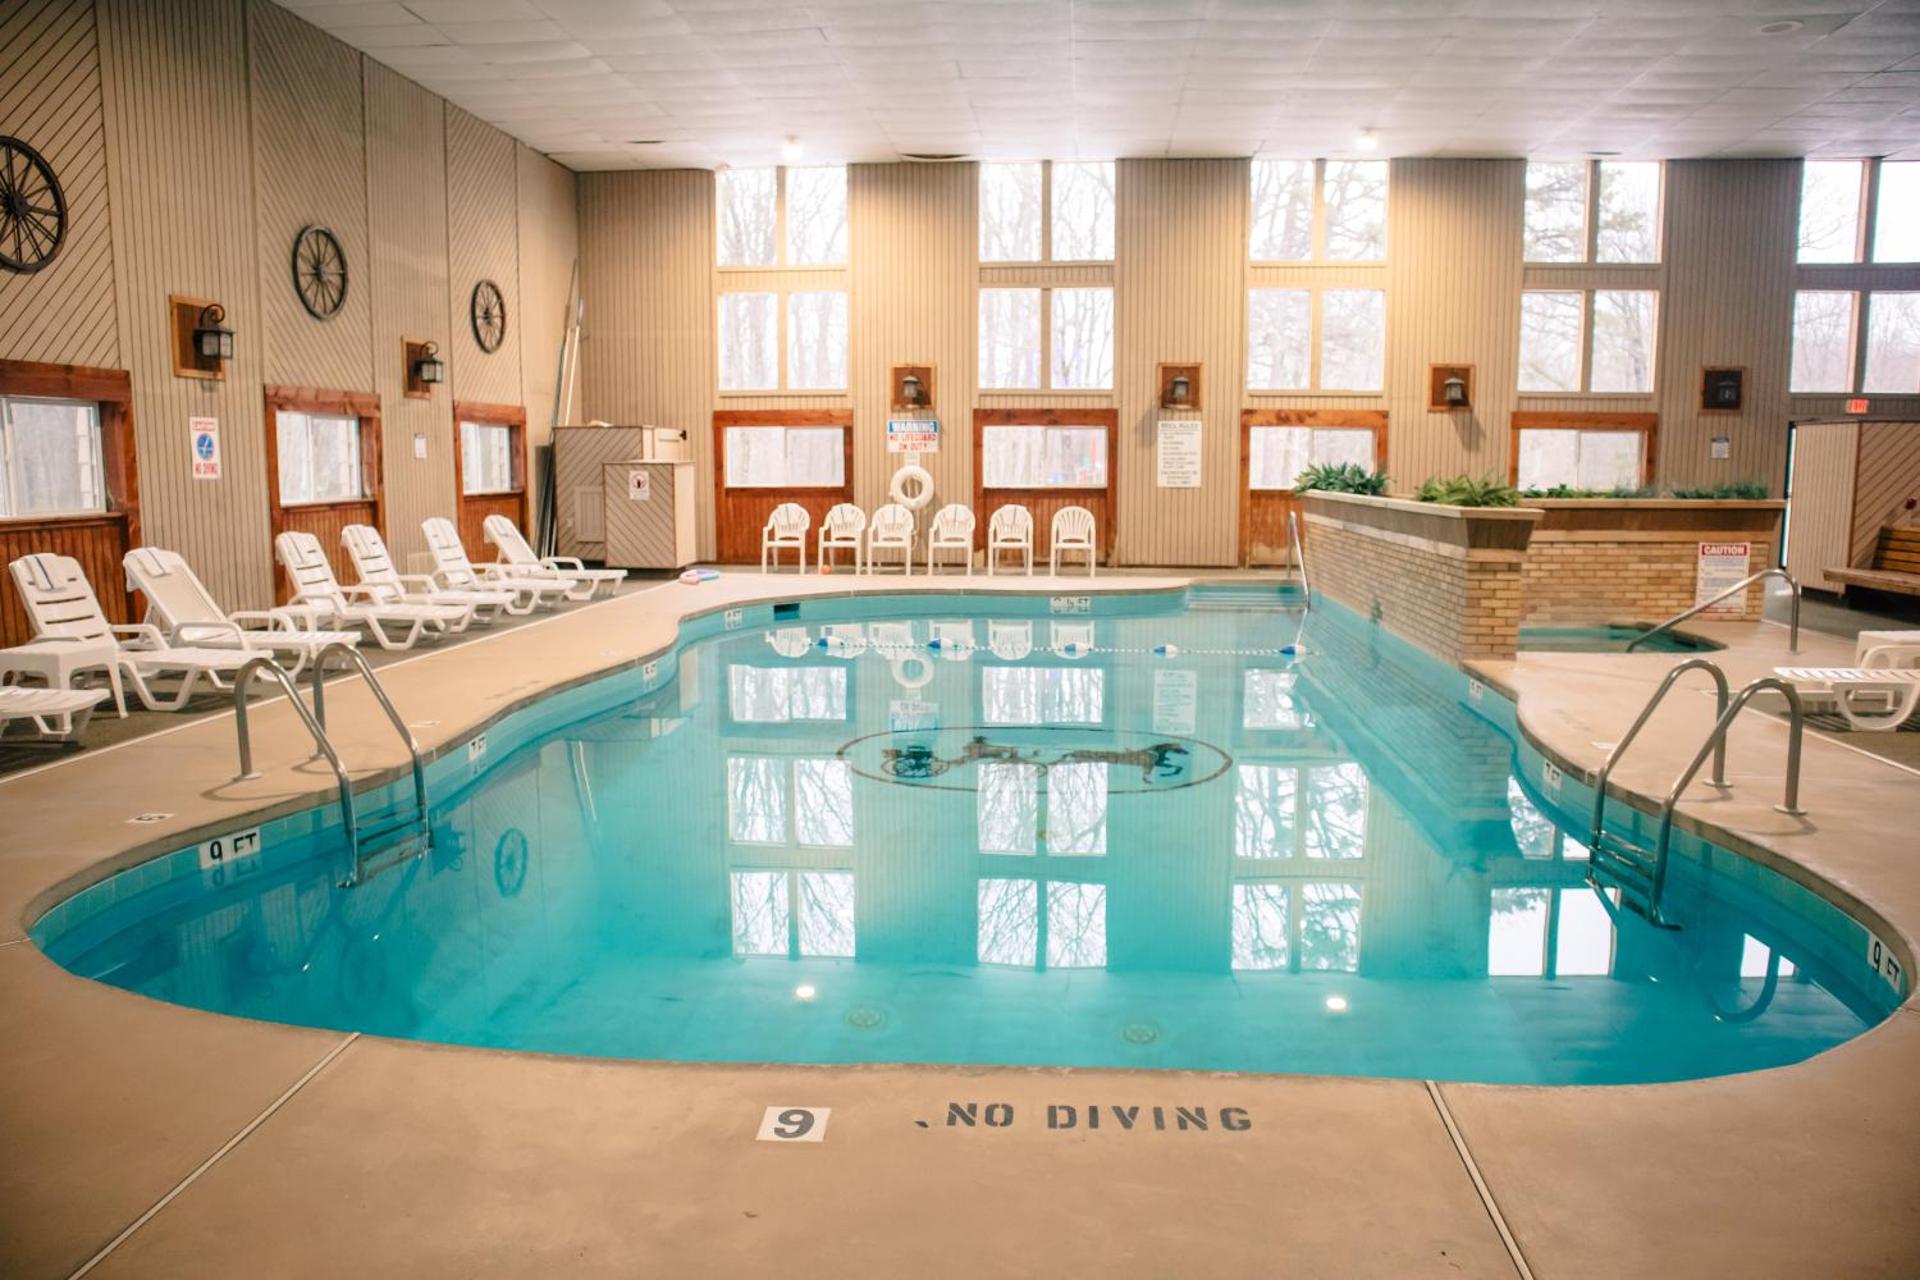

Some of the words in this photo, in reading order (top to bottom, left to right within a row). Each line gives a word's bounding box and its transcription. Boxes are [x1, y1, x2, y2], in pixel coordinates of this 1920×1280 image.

[892, 422, 935, 432] WARNING
[890, 433, 899, 441] NO
[901, 433, 937, 441] LIFEGUARD
[898, 442, 908, 450] ON
[910, 442, 928, 450] DUTY
[1703, 545, 1745, 555] CAUTION
[209, 840, 223, 861] 9
[233, 832, 257, 854] FT
[1873, 940, 1882, 973] 9
[774, 1109, 815, 1139] 9
[946, 1102, 1014, 1128] NO
[1047, 1104, 1252, 1131] DIVING
